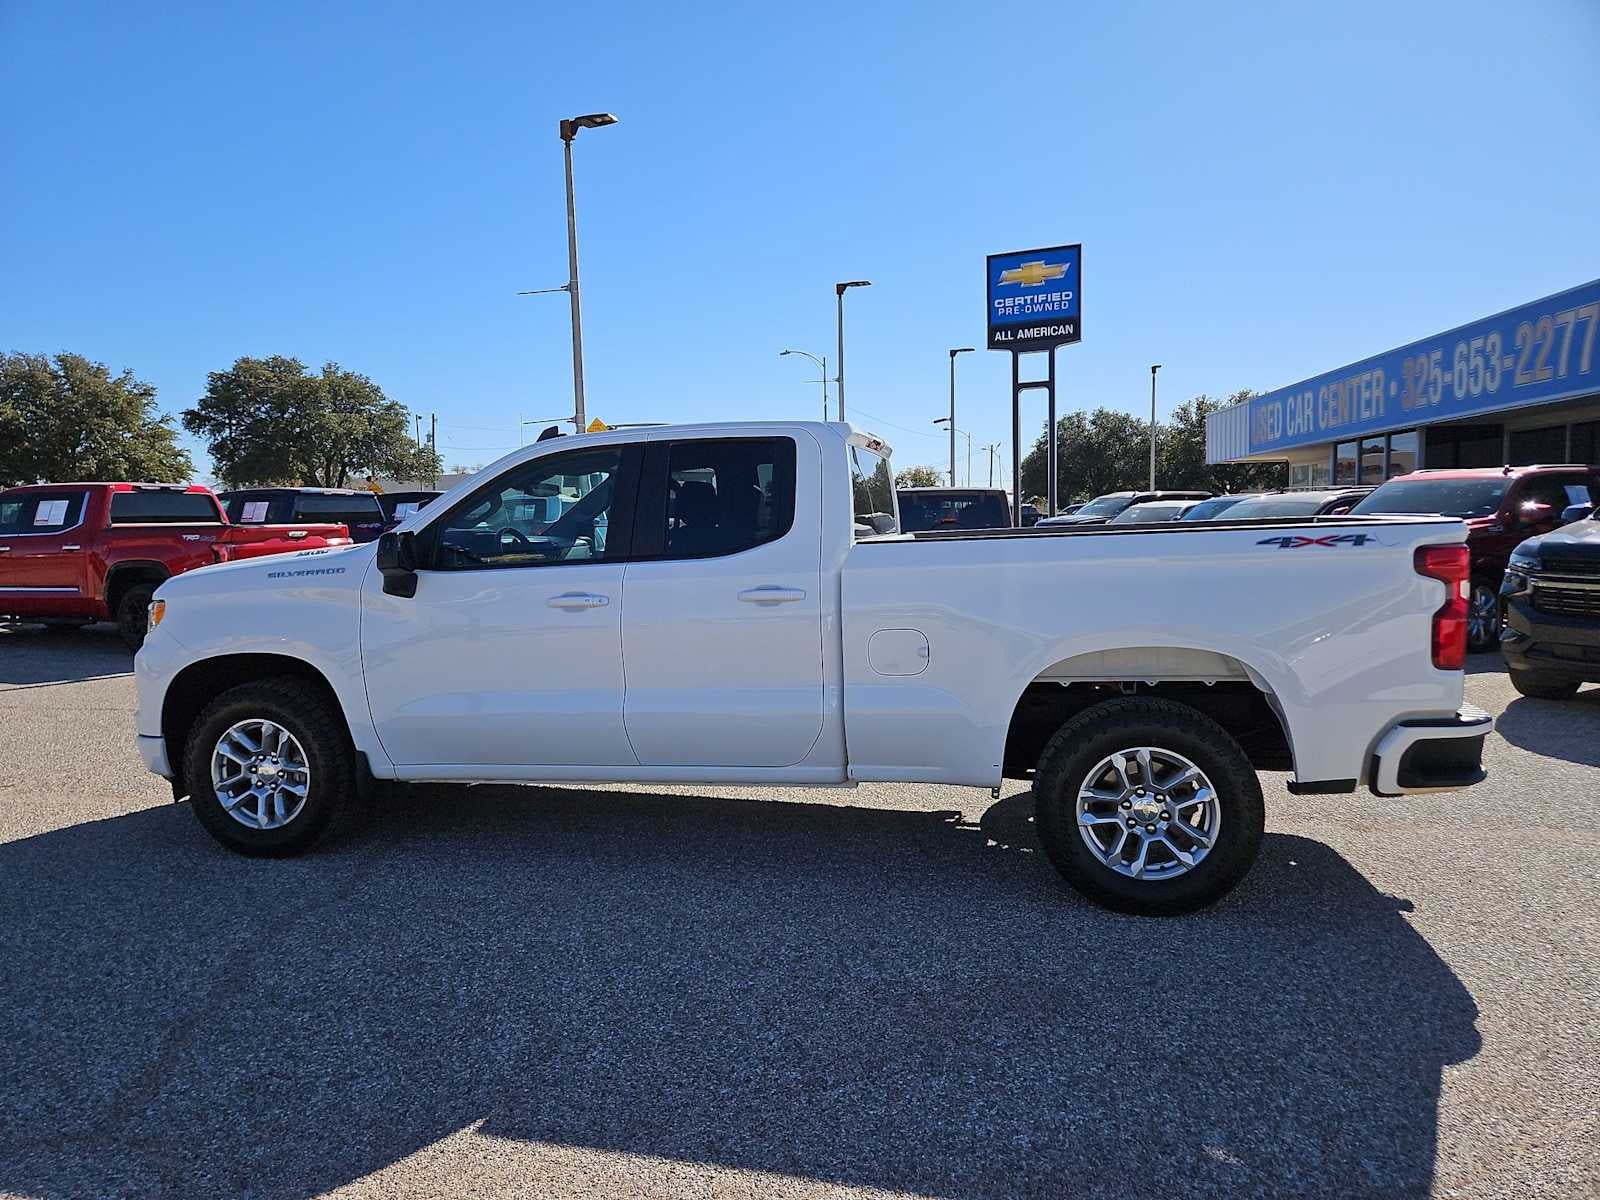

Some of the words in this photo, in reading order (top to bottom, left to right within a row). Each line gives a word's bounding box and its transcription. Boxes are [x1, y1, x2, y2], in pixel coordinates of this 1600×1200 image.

[994, 291, 1073, 308] CERTIFIED
[998, 301, 1069, 317] PRE-OWNED
[994, 331, 1014, 341] ALL
[1016, 323, 1074, 340] AMERICAN
[1286, 391, 1314, 438] CAR
[1319, 369, 1386, 431] CENTER
[267, 567, 347, 579] SILVERADO
